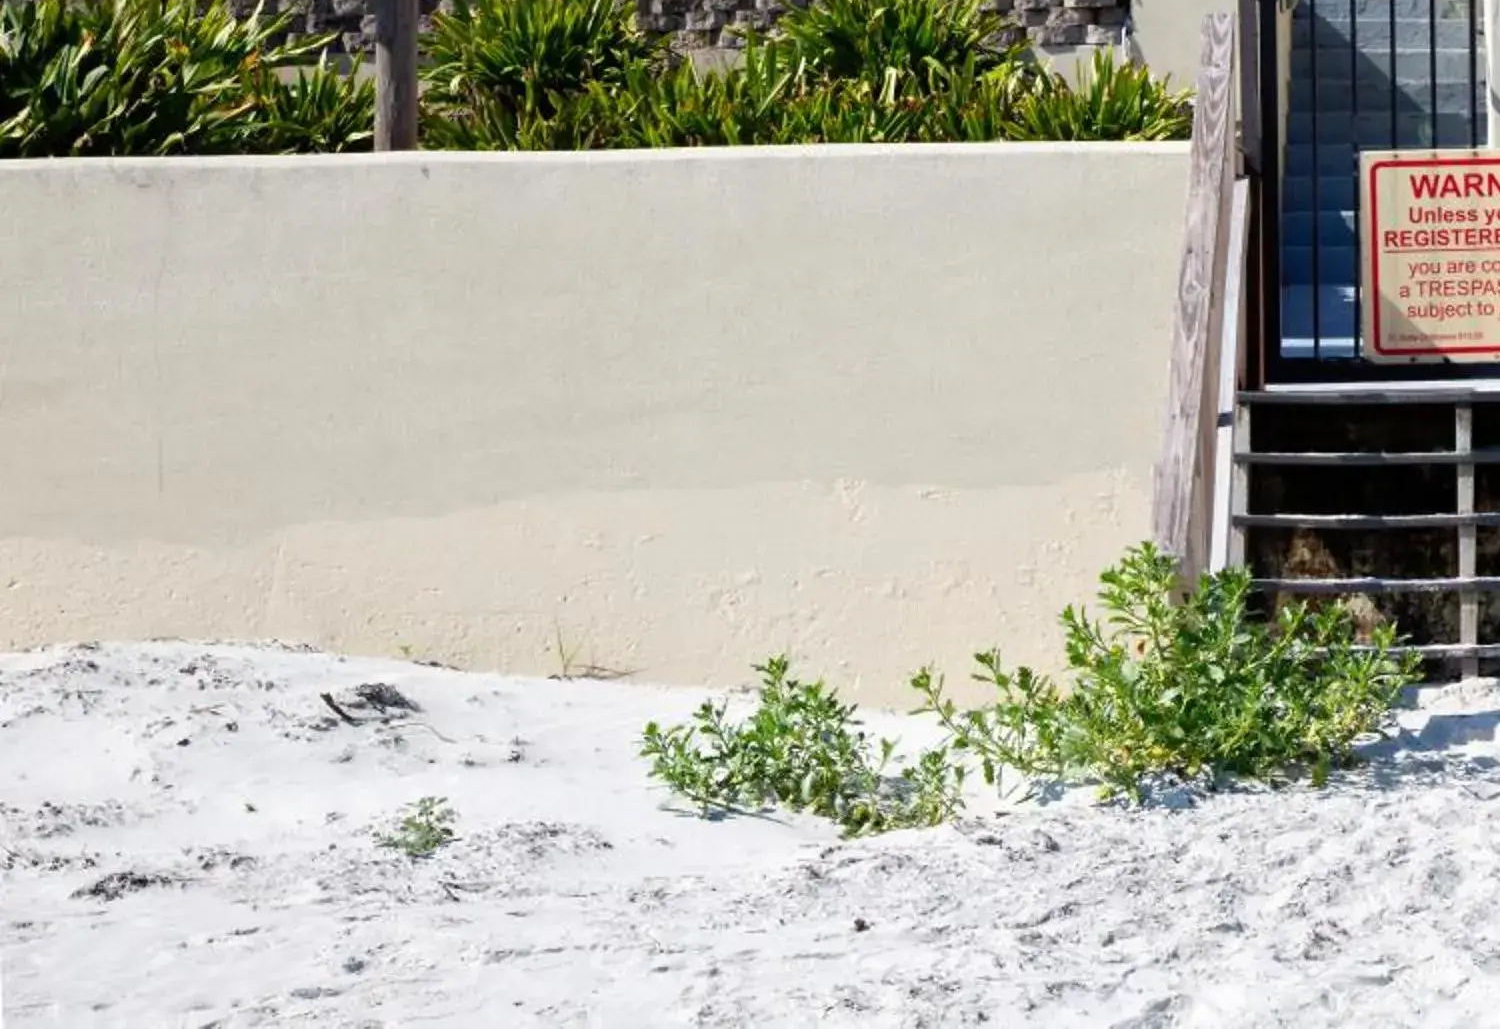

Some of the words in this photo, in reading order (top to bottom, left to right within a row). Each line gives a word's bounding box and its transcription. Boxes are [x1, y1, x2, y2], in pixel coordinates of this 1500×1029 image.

[1409, 207, 1478, 224] Unless
[1408, 262, 1440, 278] you
[1447, 260, 1476, 273] are
[1399, 286, 1410, 298] a
[1407, 302, 1472, 320] subject
[1477, 302, 1494, 315] to
